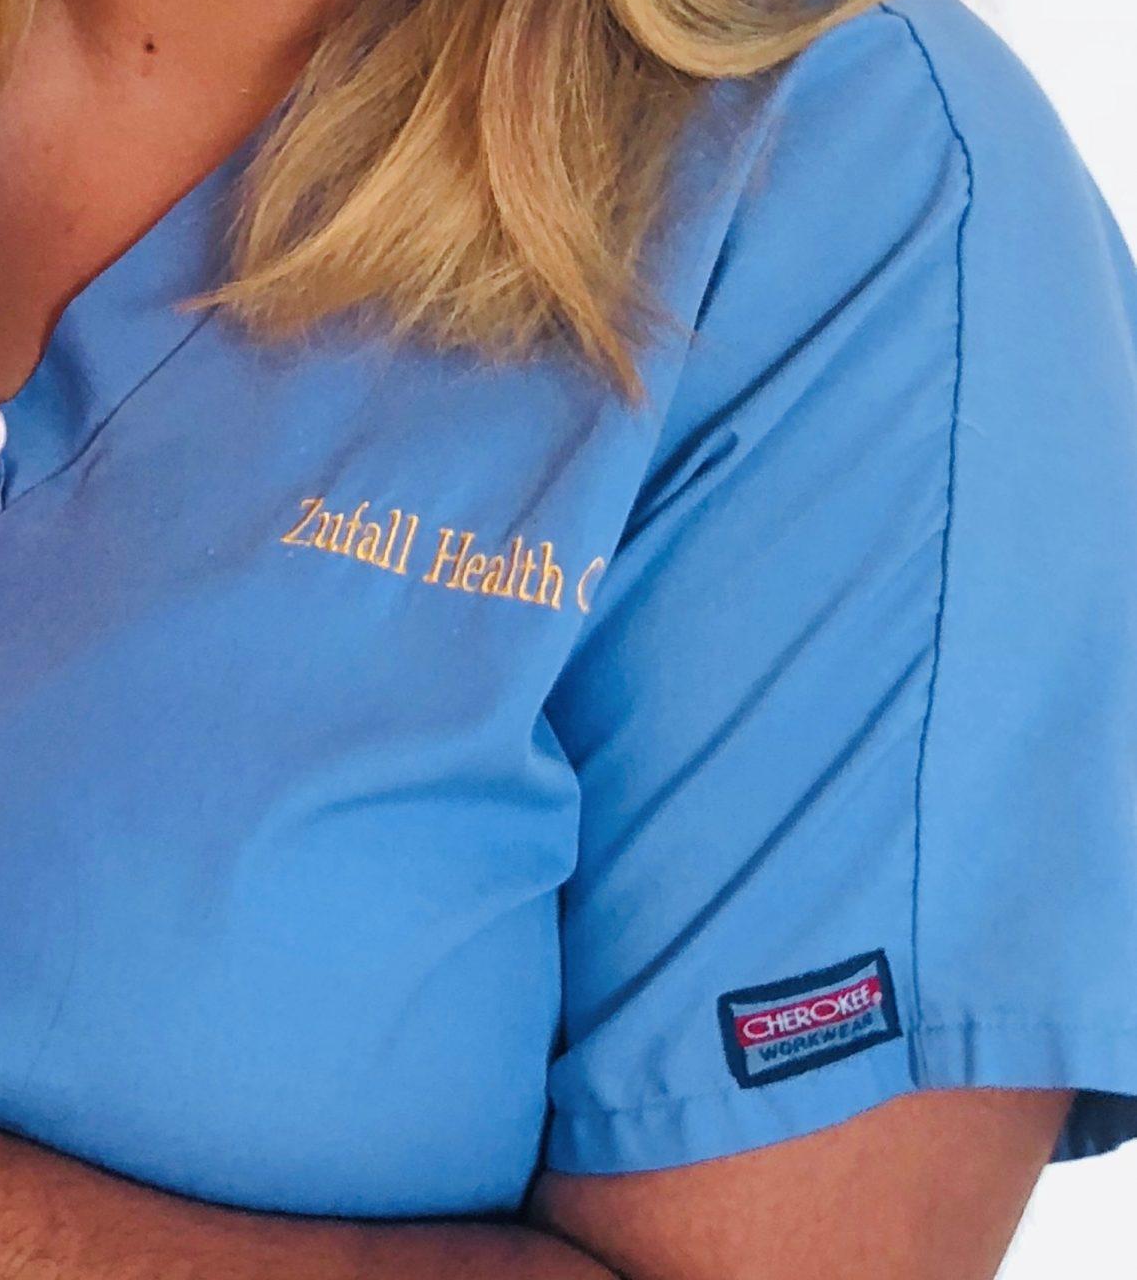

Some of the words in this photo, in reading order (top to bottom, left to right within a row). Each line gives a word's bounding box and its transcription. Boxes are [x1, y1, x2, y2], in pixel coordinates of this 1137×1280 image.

[280, 496, 419, 575] Zufall
[423, 528, 564, 611] Health
[742, 983, 872, 1040] CHEROKEE
[758, 1011, 875, 1062] WORKWEAR
